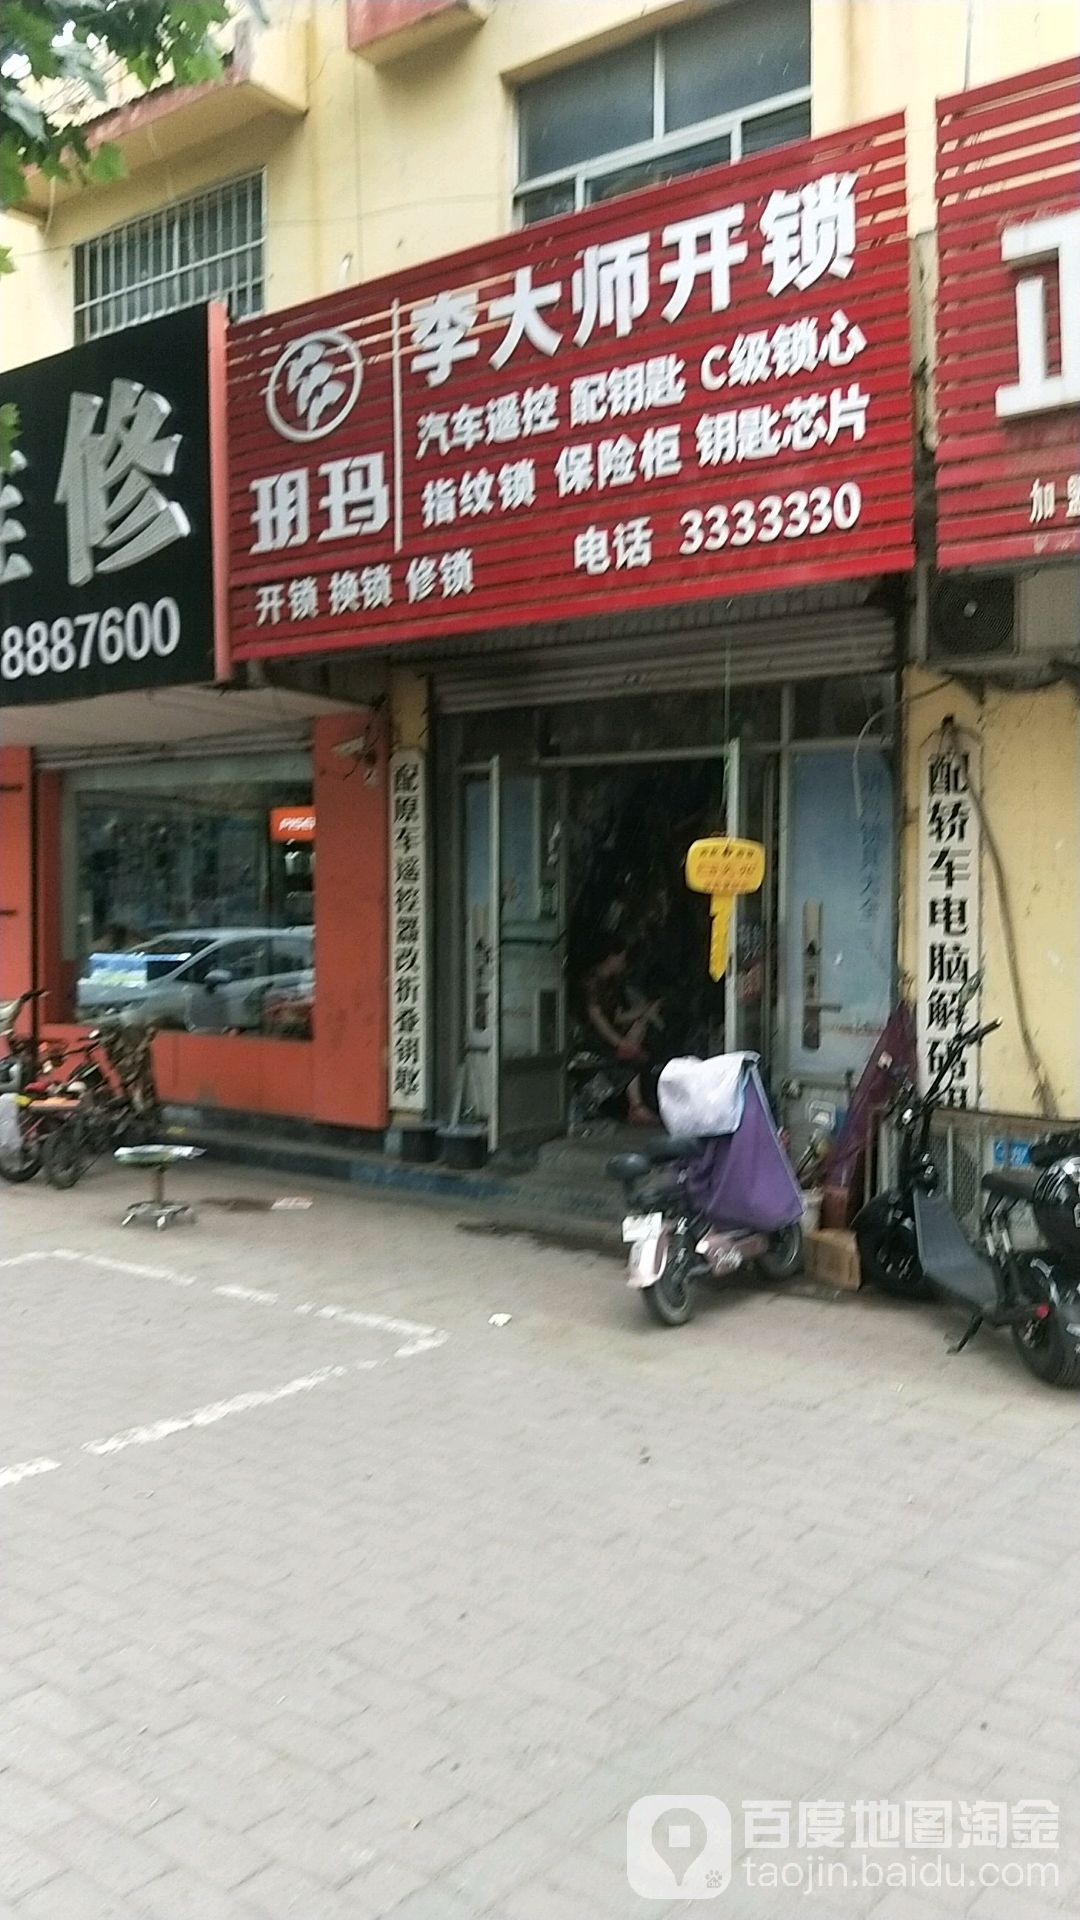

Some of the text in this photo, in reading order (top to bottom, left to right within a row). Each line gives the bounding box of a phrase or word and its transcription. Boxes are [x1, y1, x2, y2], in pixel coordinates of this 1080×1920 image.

[411, 172, 858, 388] 李大师开锁
[416, 309, 867, 460] 汽车遥控 配钥匙 C级锁心
[421, 383, 870, 529] 指纹锁 保险柜 钥匙芯片
[249, 451, 390, 556] 玥玛
[256, 482, 861, 627] 开锁 换锁 修锁 电话 3333330
[0, 599, 181, 681] 8887600
